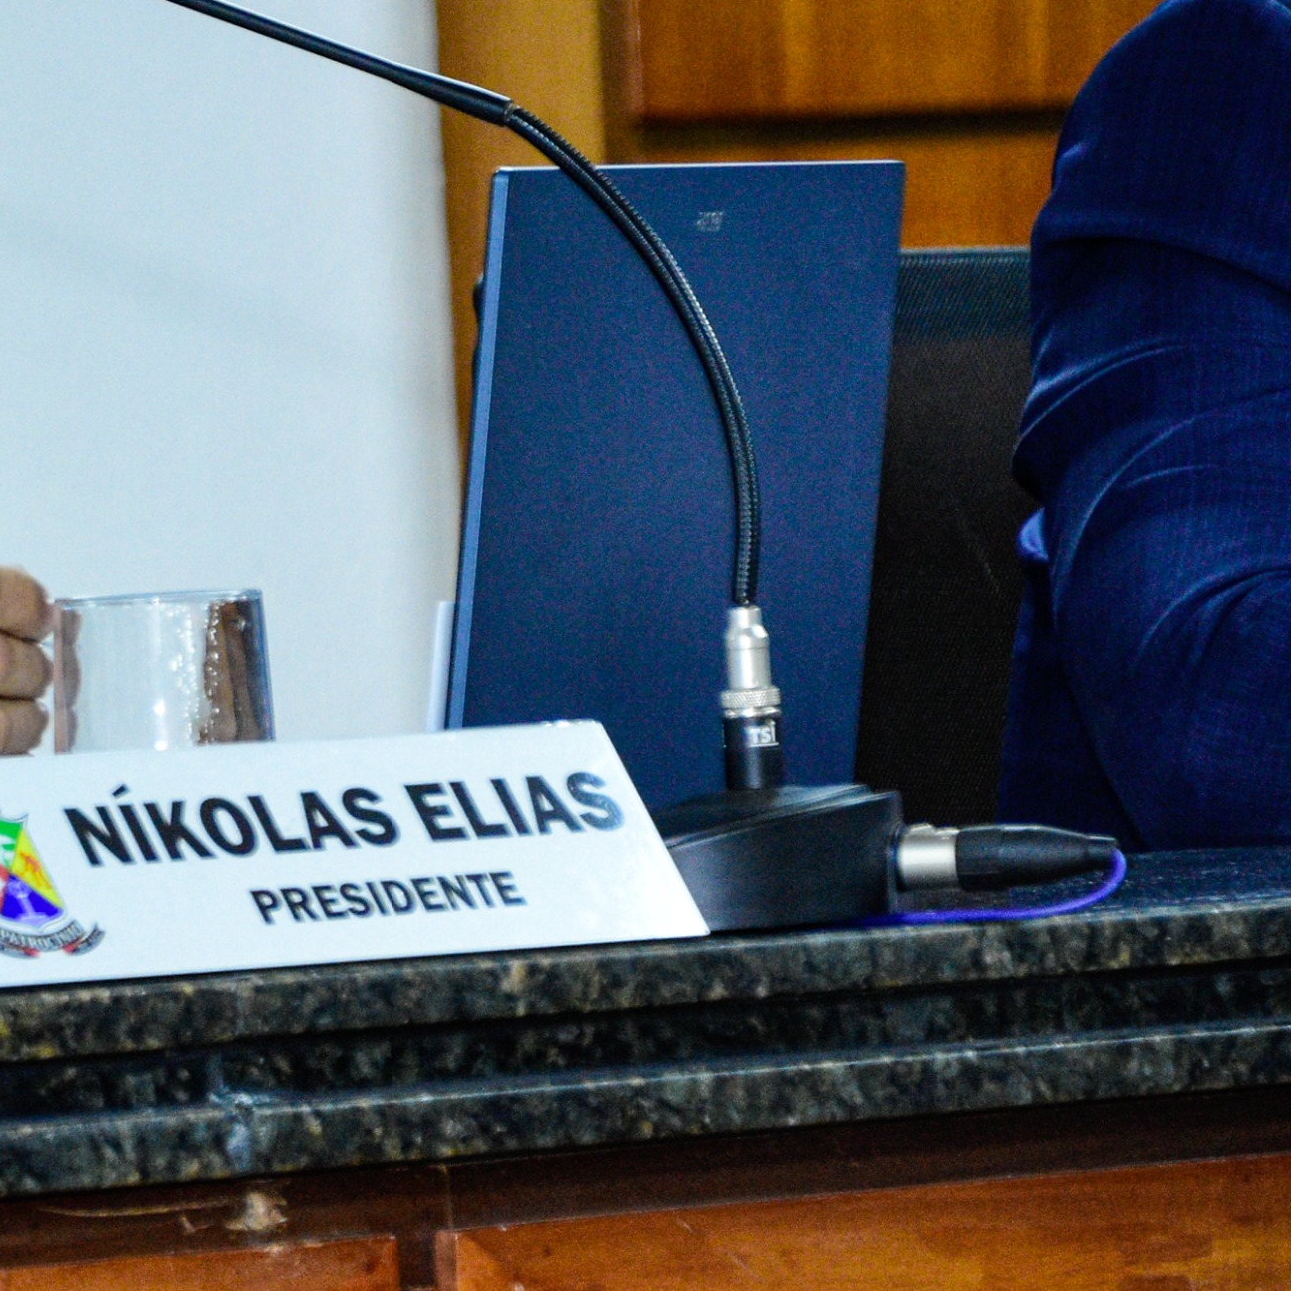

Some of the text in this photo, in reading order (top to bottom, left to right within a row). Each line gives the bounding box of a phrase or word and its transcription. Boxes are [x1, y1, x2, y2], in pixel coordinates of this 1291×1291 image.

[64, 772, 624, 866] NÍKOLAS ELIAS
[250, 871, 526, 924] PRESIDENTE
